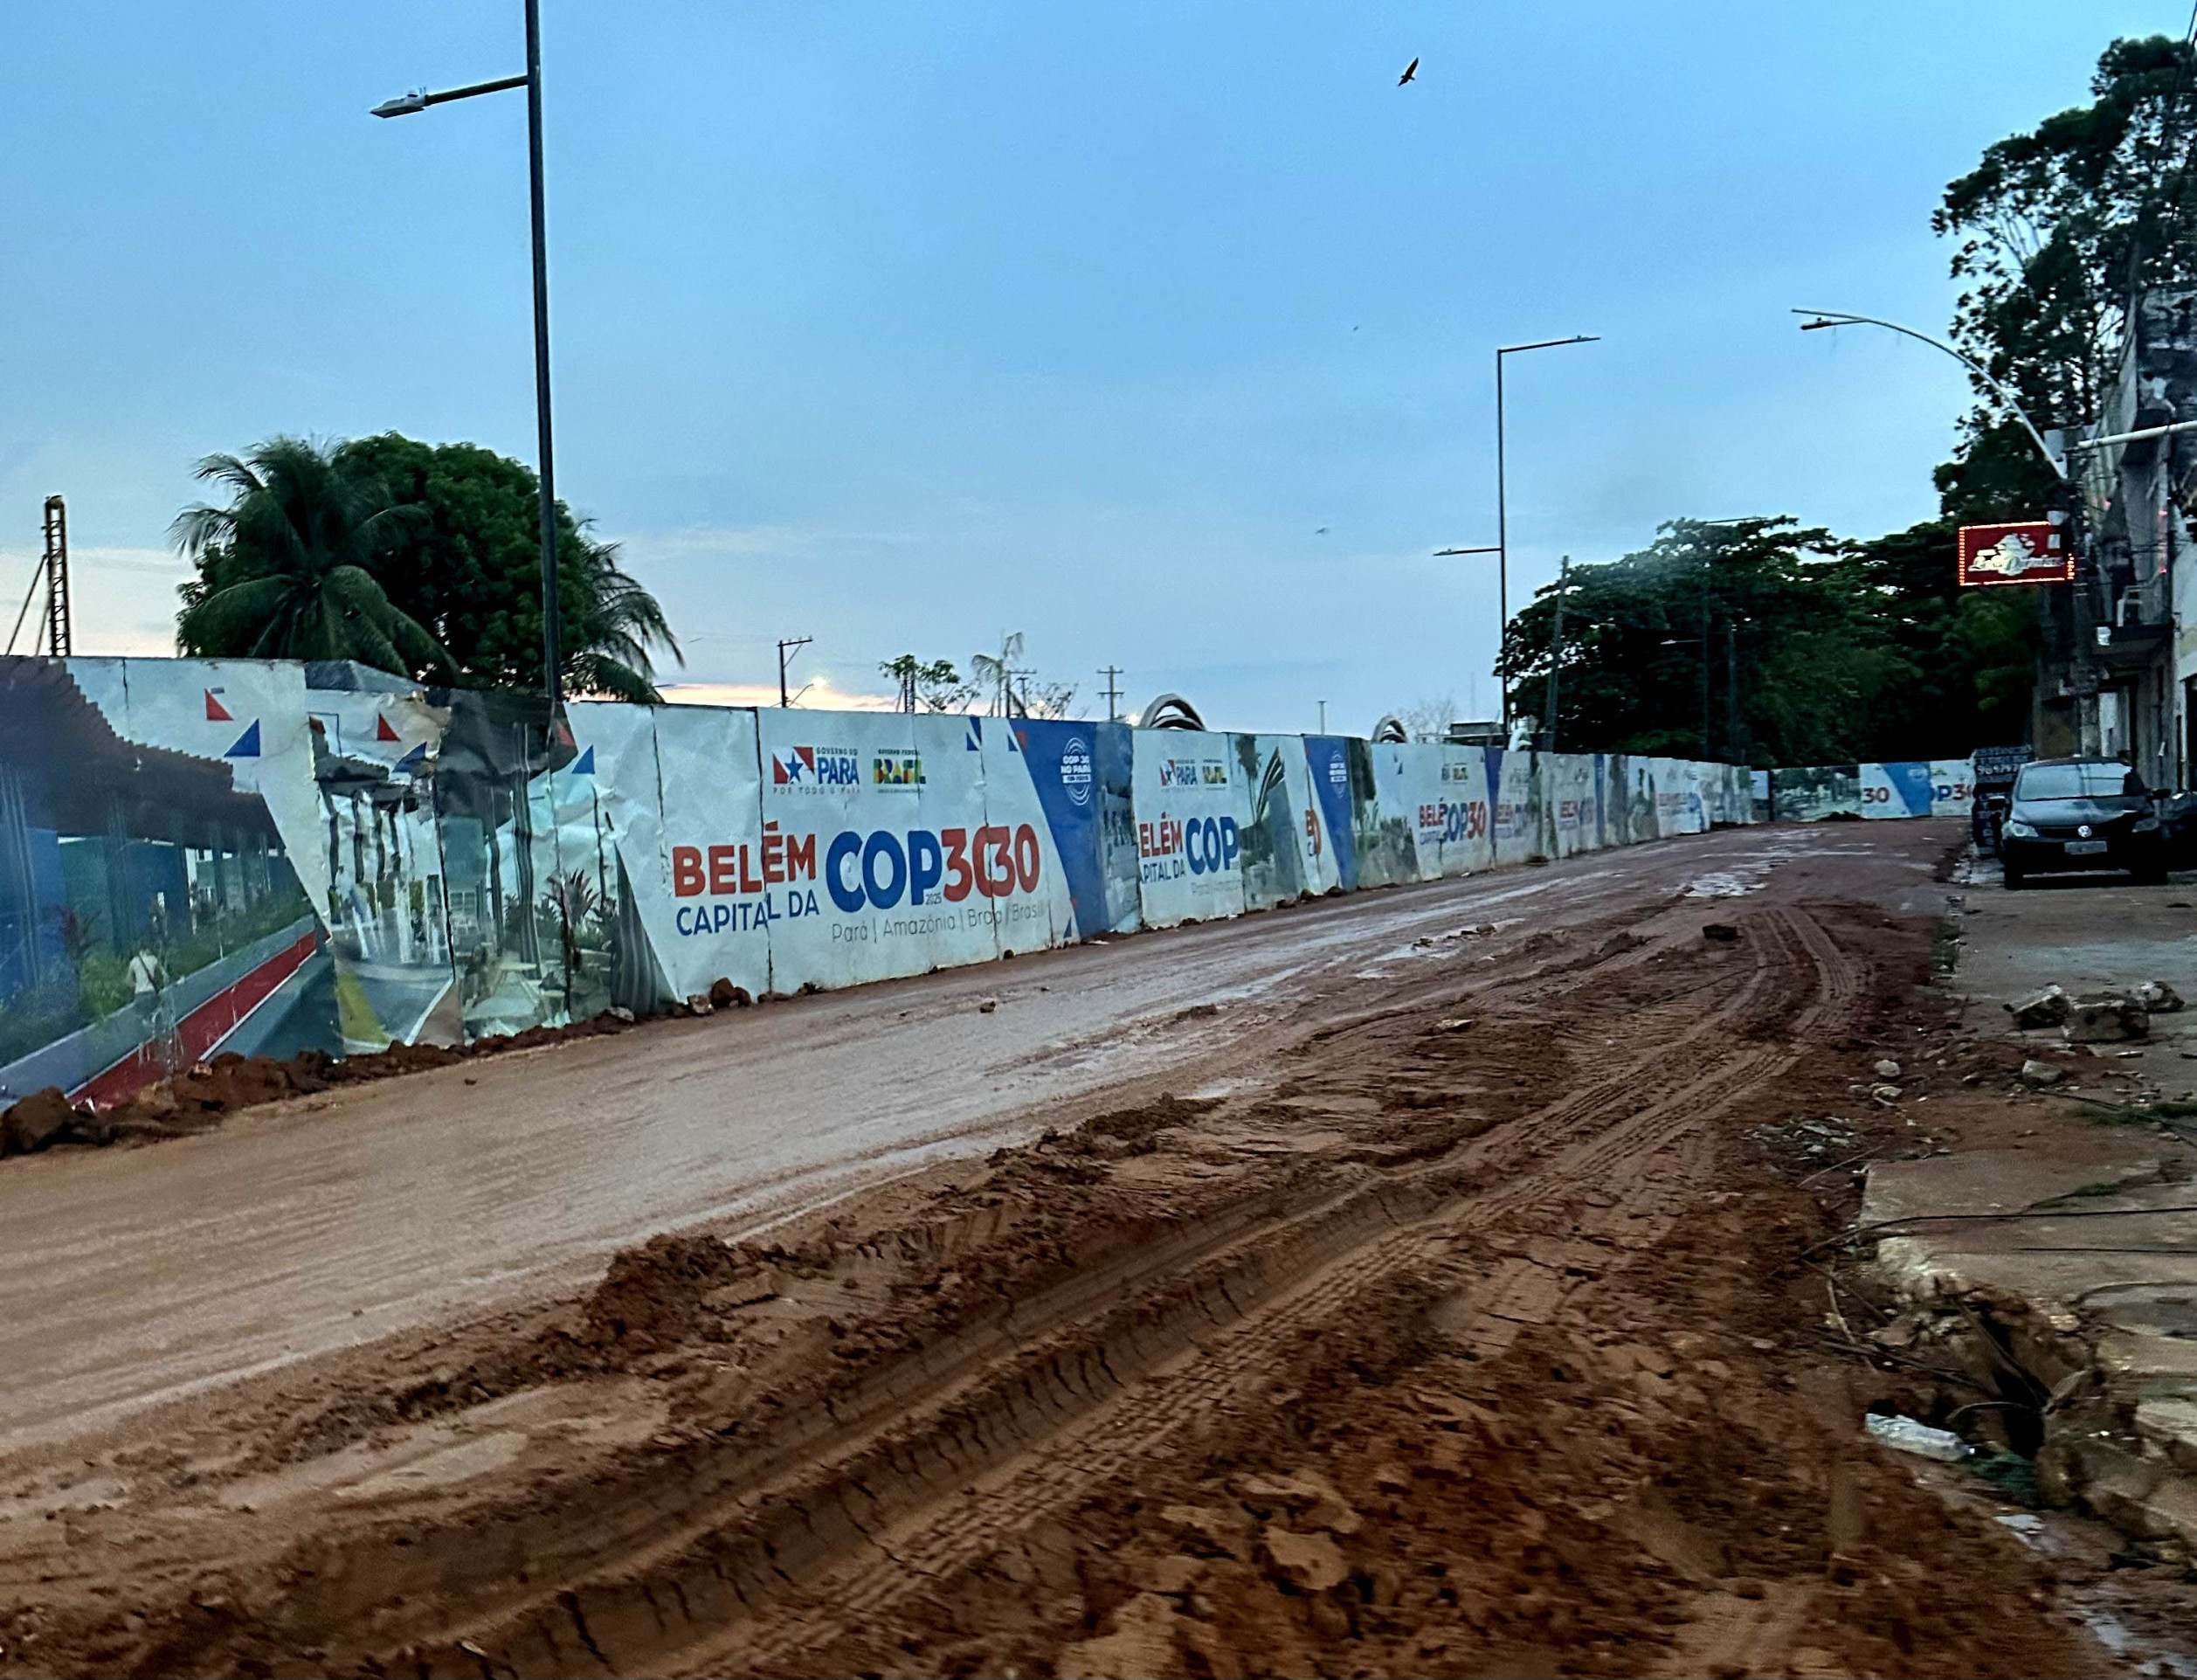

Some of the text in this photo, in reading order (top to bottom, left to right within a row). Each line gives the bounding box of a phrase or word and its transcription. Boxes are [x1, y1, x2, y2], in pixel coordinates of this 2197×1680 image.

[1862, 786, 1890, 804] 30
[673, 820, 816, 897] BELÉM
[1185, 816, 1240, 875] COP
[676, 889, 819, 936] CAPITAL DA
[832, 920, 868, 943] Pará
